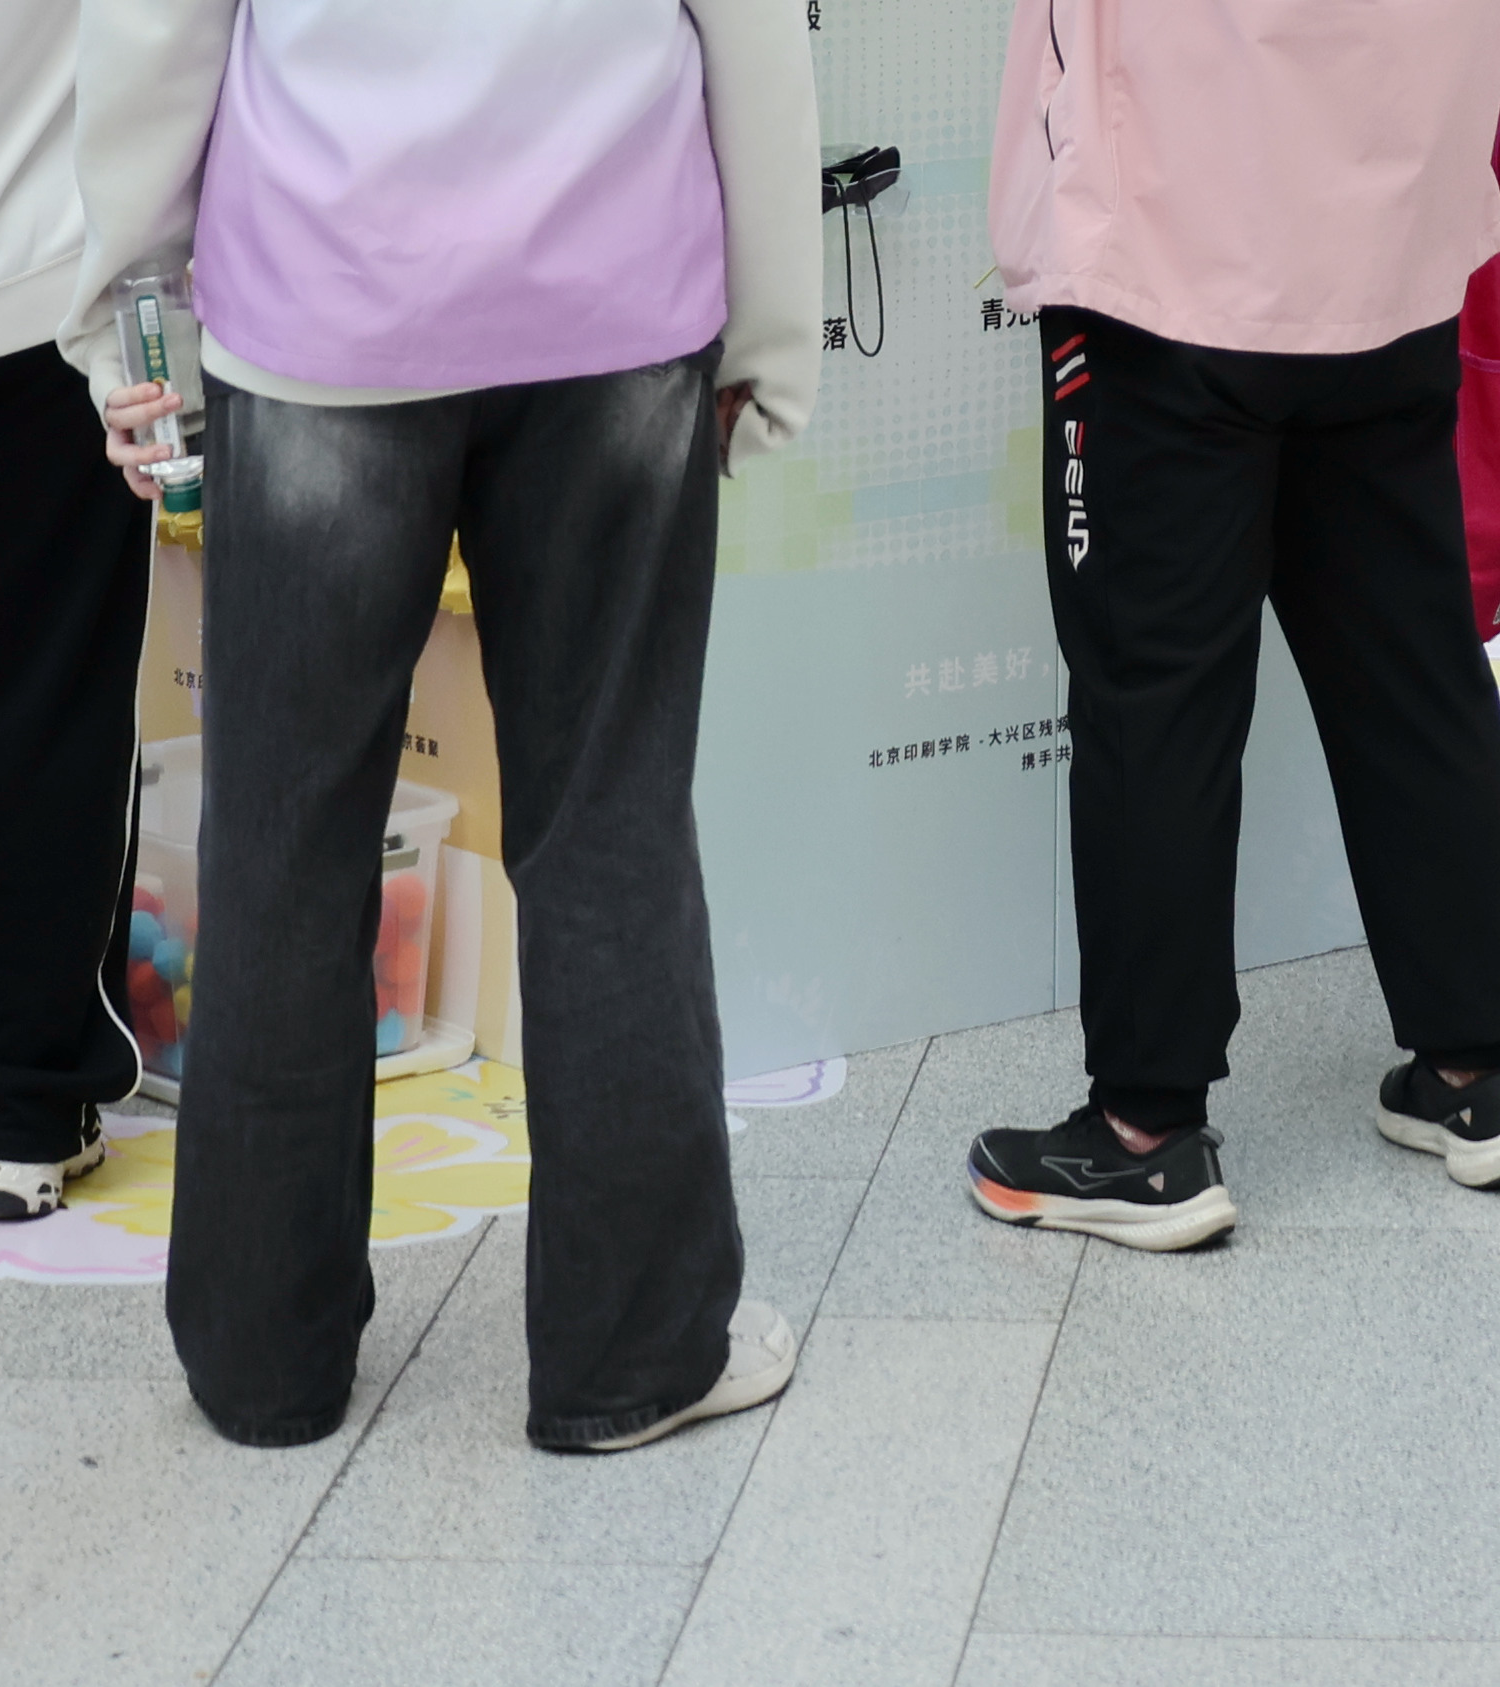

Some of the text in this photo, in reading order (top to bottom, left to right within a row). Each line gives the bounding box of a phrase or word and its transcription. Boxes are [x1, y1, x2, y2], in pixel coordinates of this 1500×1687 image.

[868, 733, 971, 769] 北京印刷学院
